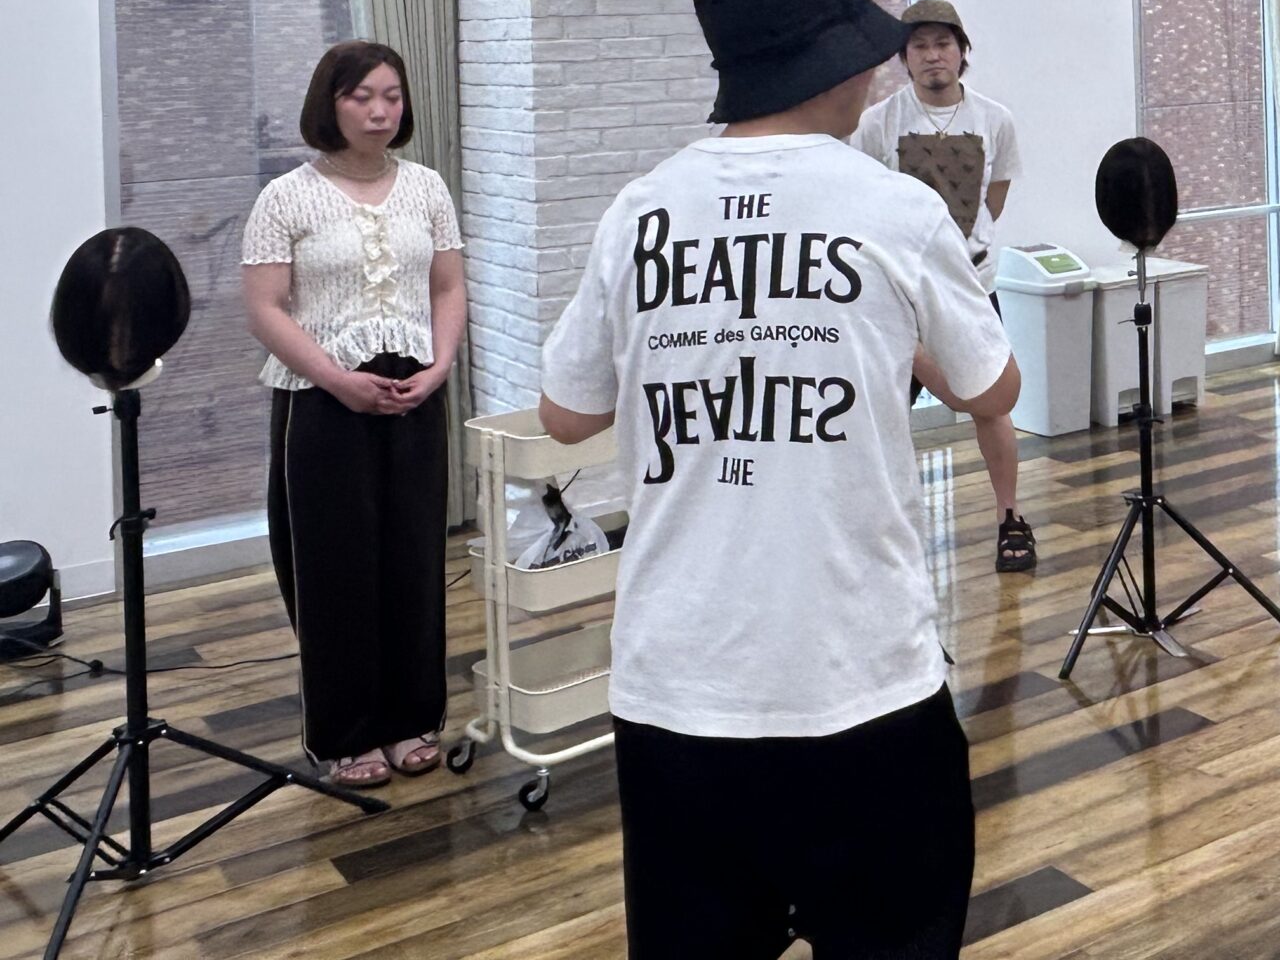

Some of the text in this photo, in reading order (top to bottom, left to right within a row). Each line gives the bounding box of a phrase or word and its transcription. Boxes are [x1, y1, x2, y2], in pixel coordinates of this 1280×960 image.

[718, 193, 772, 221] THE
[632, 208, 863, 319] BEATLES
[648, 324, 840, 351] COMME des GARÇONS
